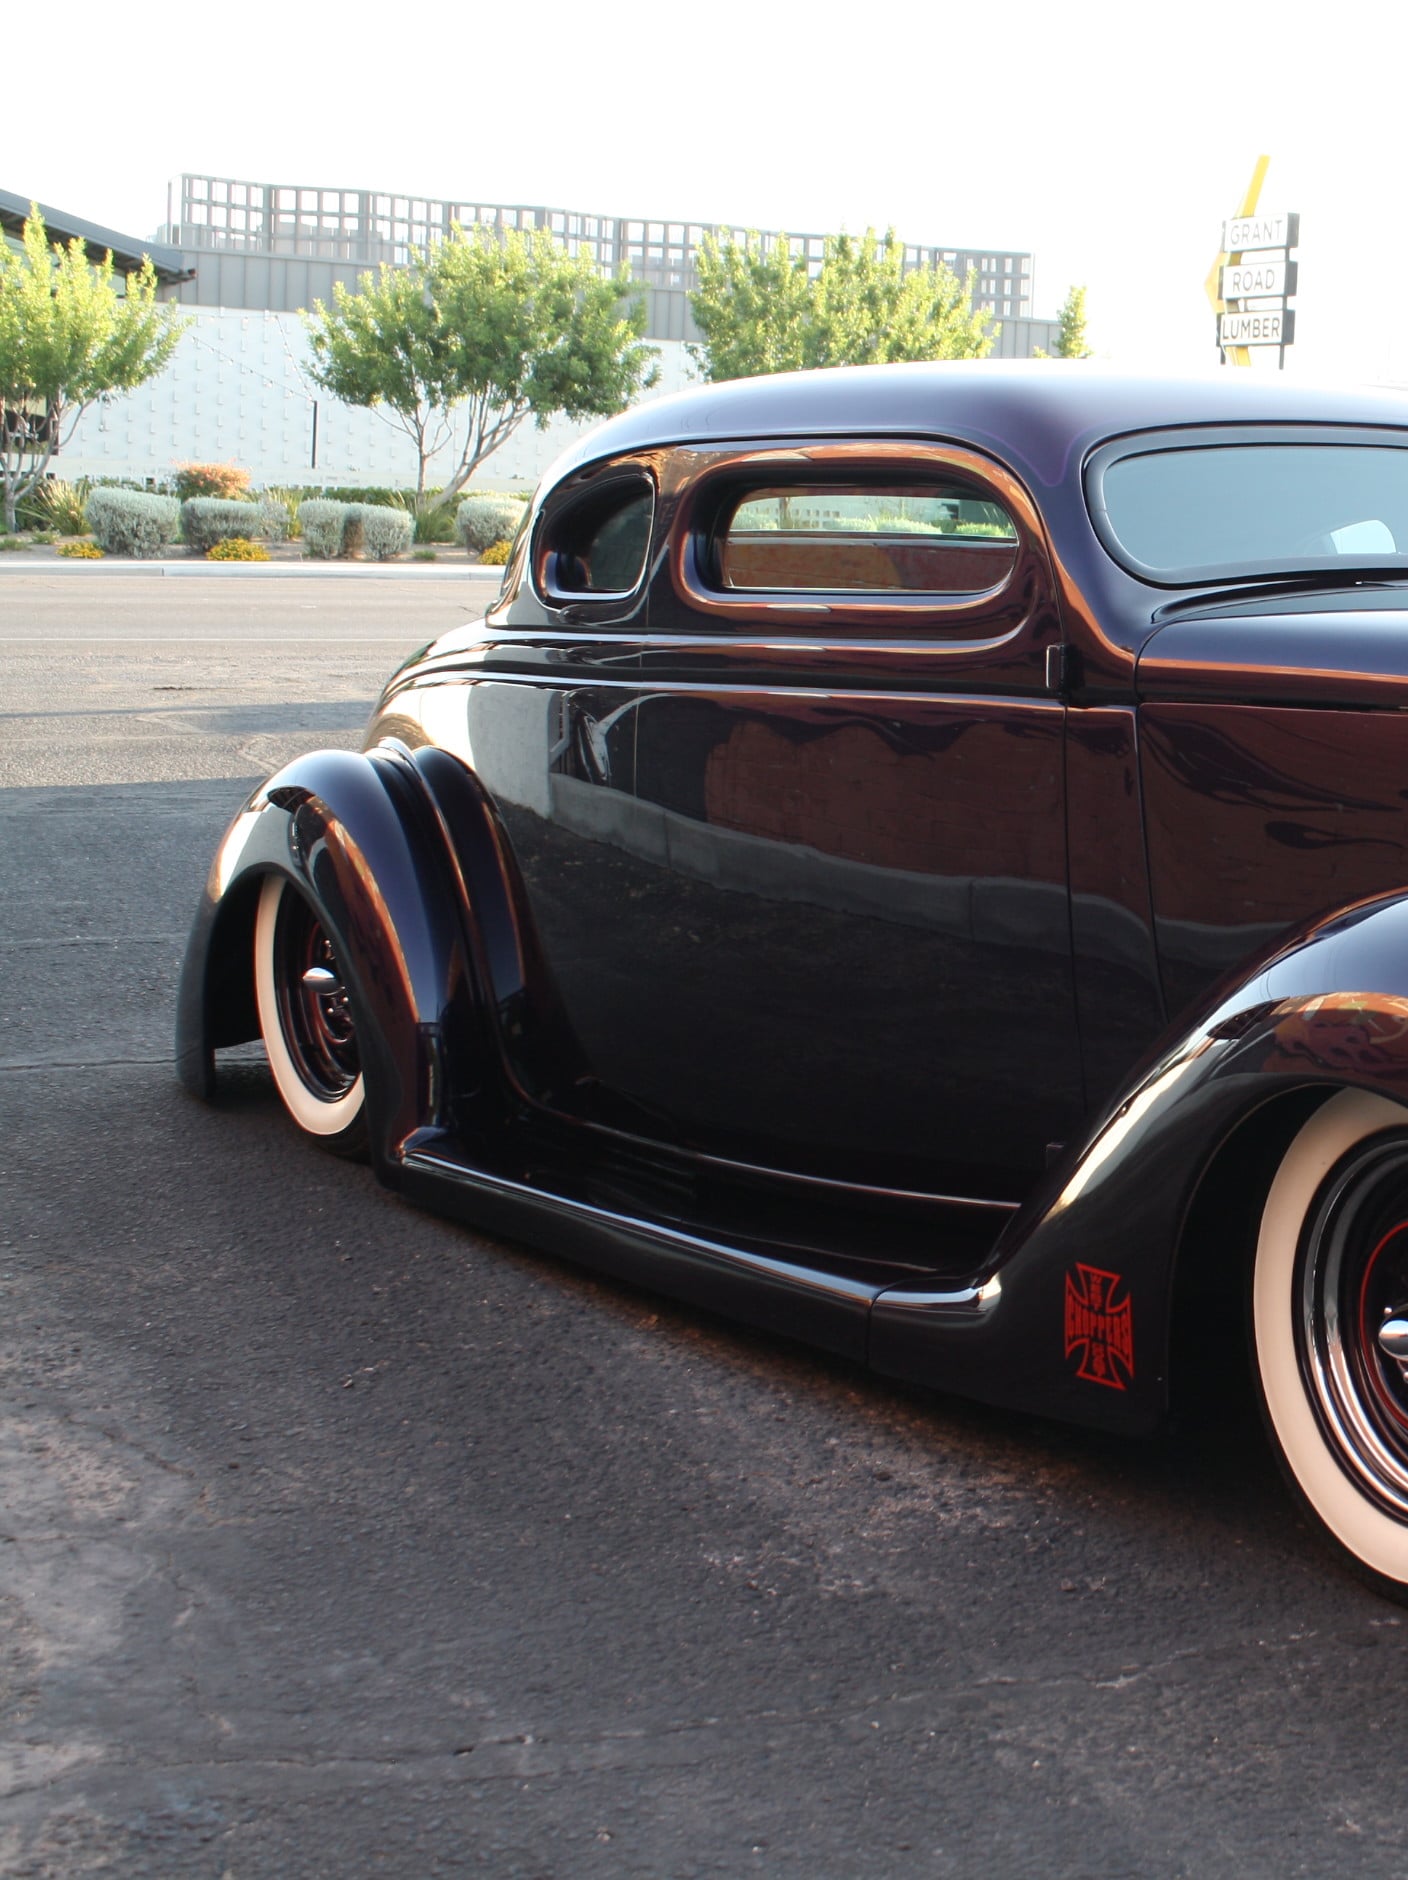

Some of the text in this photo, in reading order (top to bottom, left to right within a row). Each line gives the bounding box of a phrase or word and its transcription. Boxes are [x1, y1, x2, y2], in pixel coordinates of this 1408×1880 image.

[1230, 220, 1283, 245] GRANT
[1232, 269, 1275, 293] ROAD
[1222, 317, 1281, 340] LUMBER
